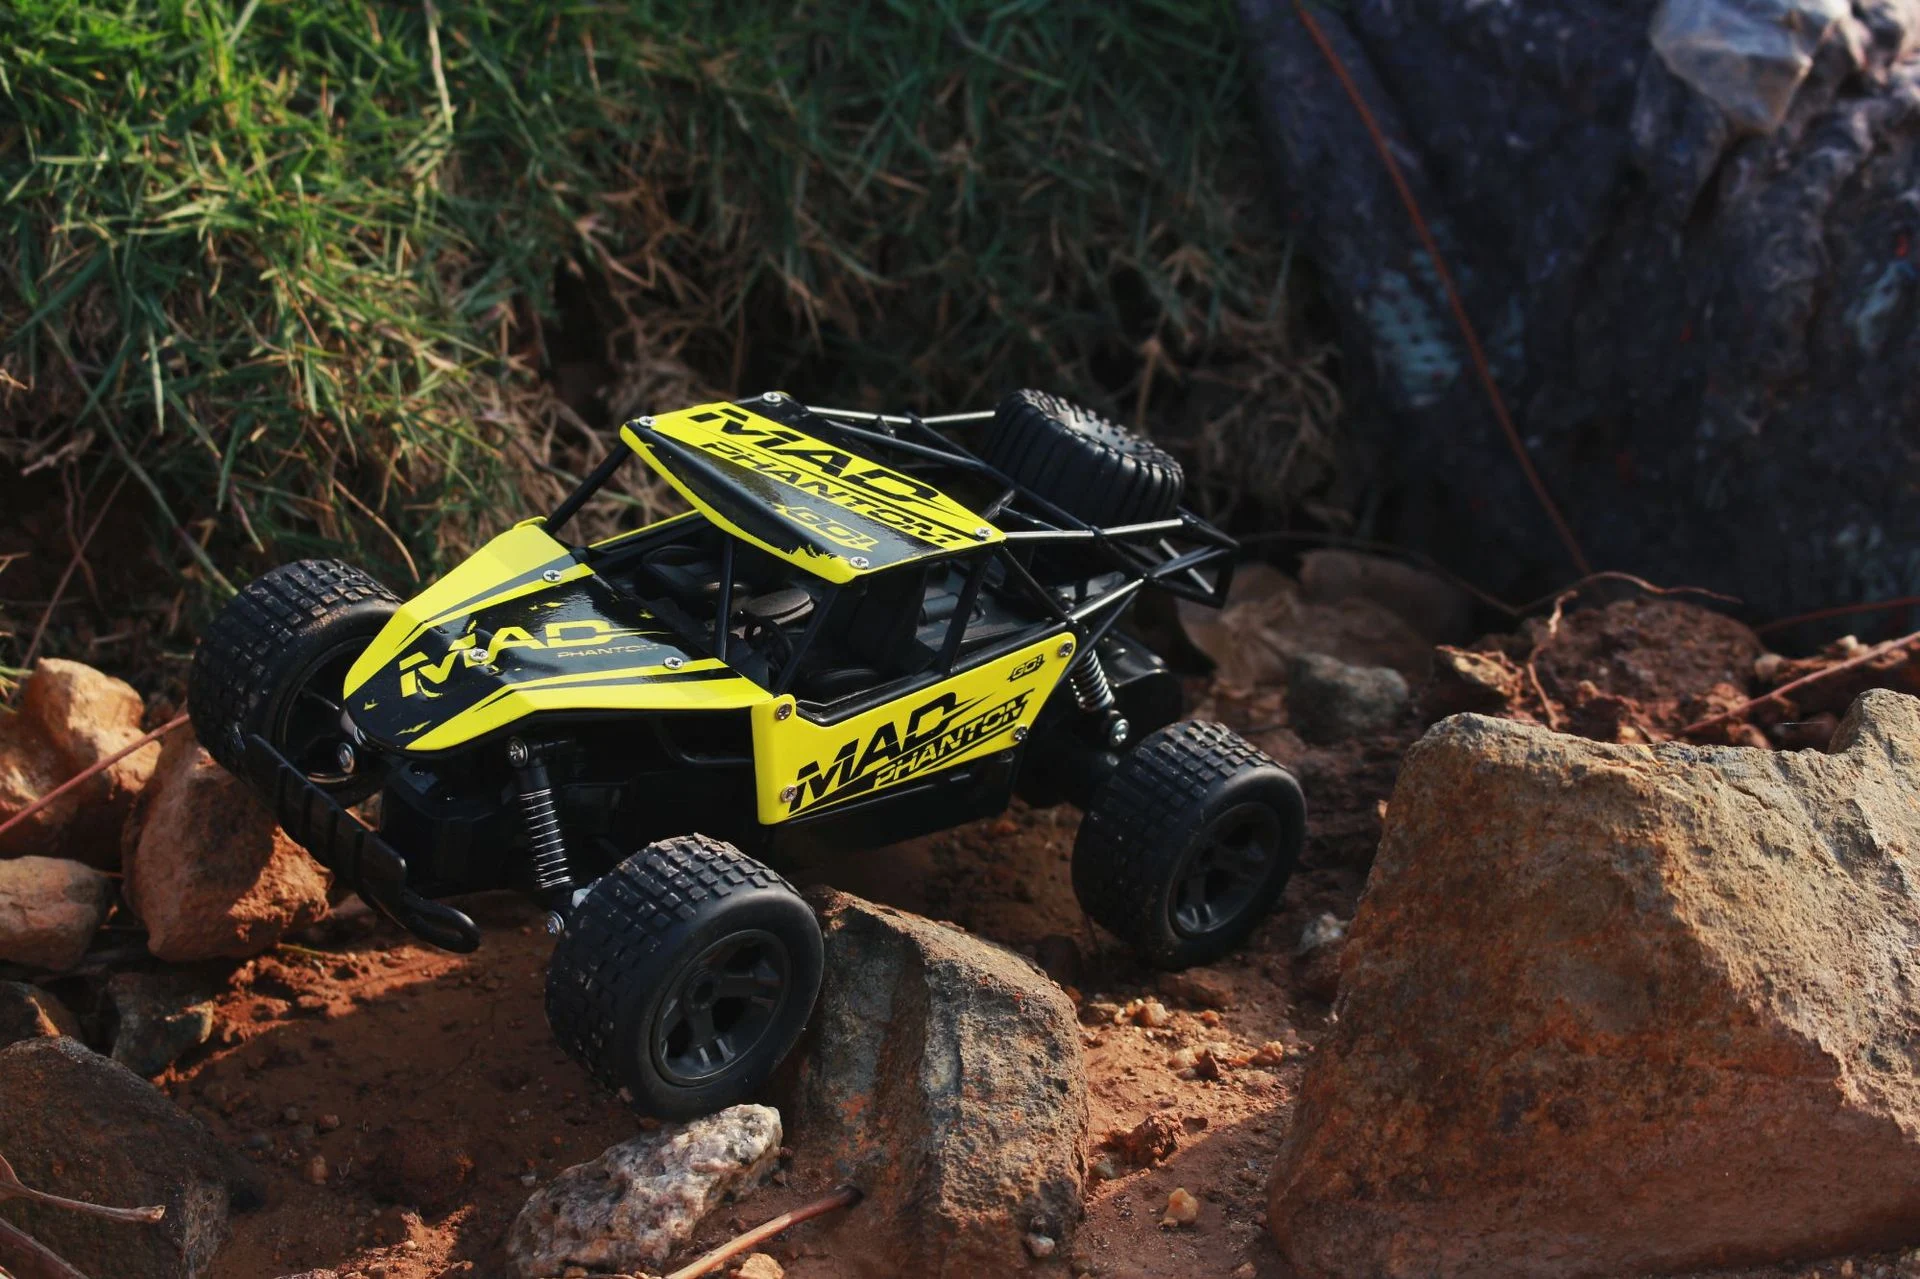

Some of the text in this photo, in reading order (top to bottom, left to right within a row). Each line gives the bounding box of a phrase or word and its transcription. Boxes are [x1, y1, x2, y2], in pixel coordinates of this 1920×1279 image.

[688, 408, 941, 502] MAD
[700, 441, 961, 544] PHANTOM
[400, 619, 613, 698] MAD
[788, 692, 958, 814] MAD
[872, 697, 1030, 789] PHANTOM
